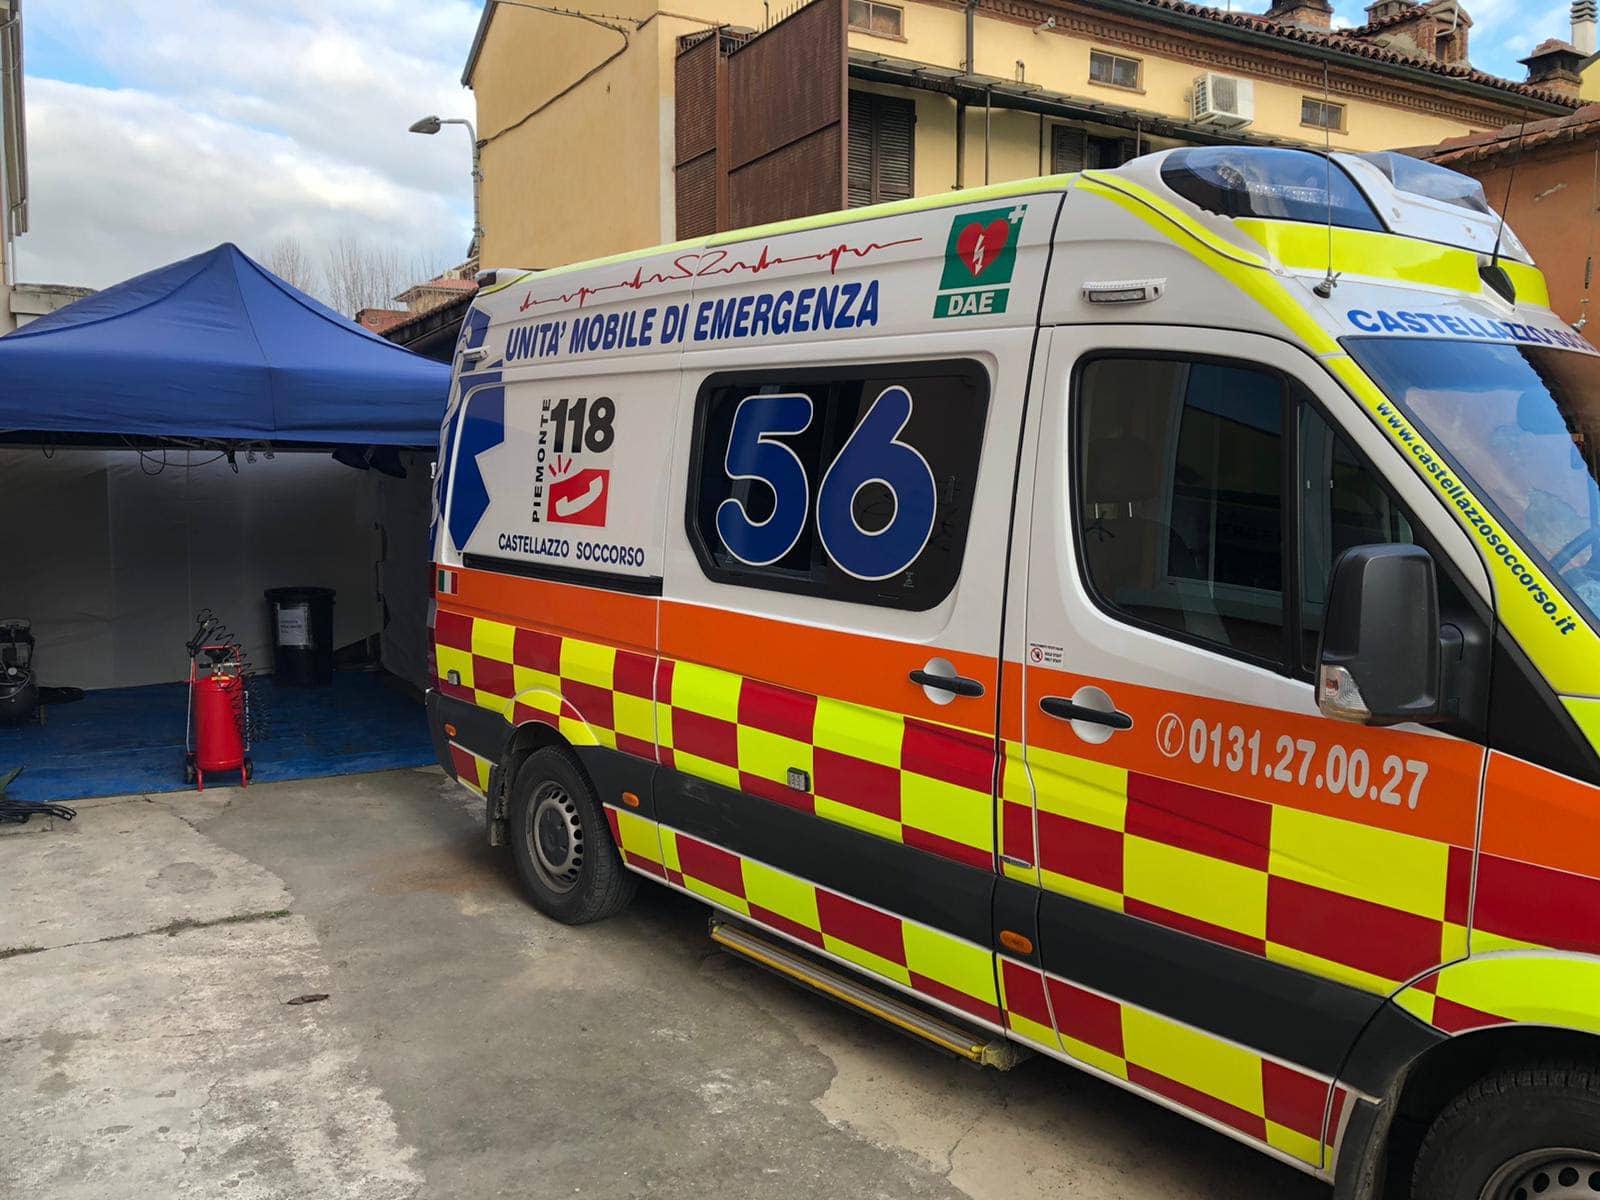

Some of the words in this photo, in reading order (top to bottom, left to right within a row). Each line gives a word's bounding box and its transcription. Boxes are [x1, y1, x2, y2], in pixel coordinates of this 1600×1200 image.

[569, 309, 656, 354] MOBILE
[660, 303, 690, 344] DI
[693, 279, 880, 341] EMERGENZA
[947, 291, 995, 316] DAE
[1347, 309, 1553, 345] CASTELLAZZO
[532, 398, 551, 523] PIEMONTE
[550, 396, 616, 453] 118
[716, 385, 937, 580] 56
[1376, 402, 1577, 636] www.castellazzosoccorso.it
[498, 533, 570, 558] CASTELLAZZO
[575, 541, 645, 567] SOCCORSO
[1188, 718, 1430, 810] 0131.27.00.27
